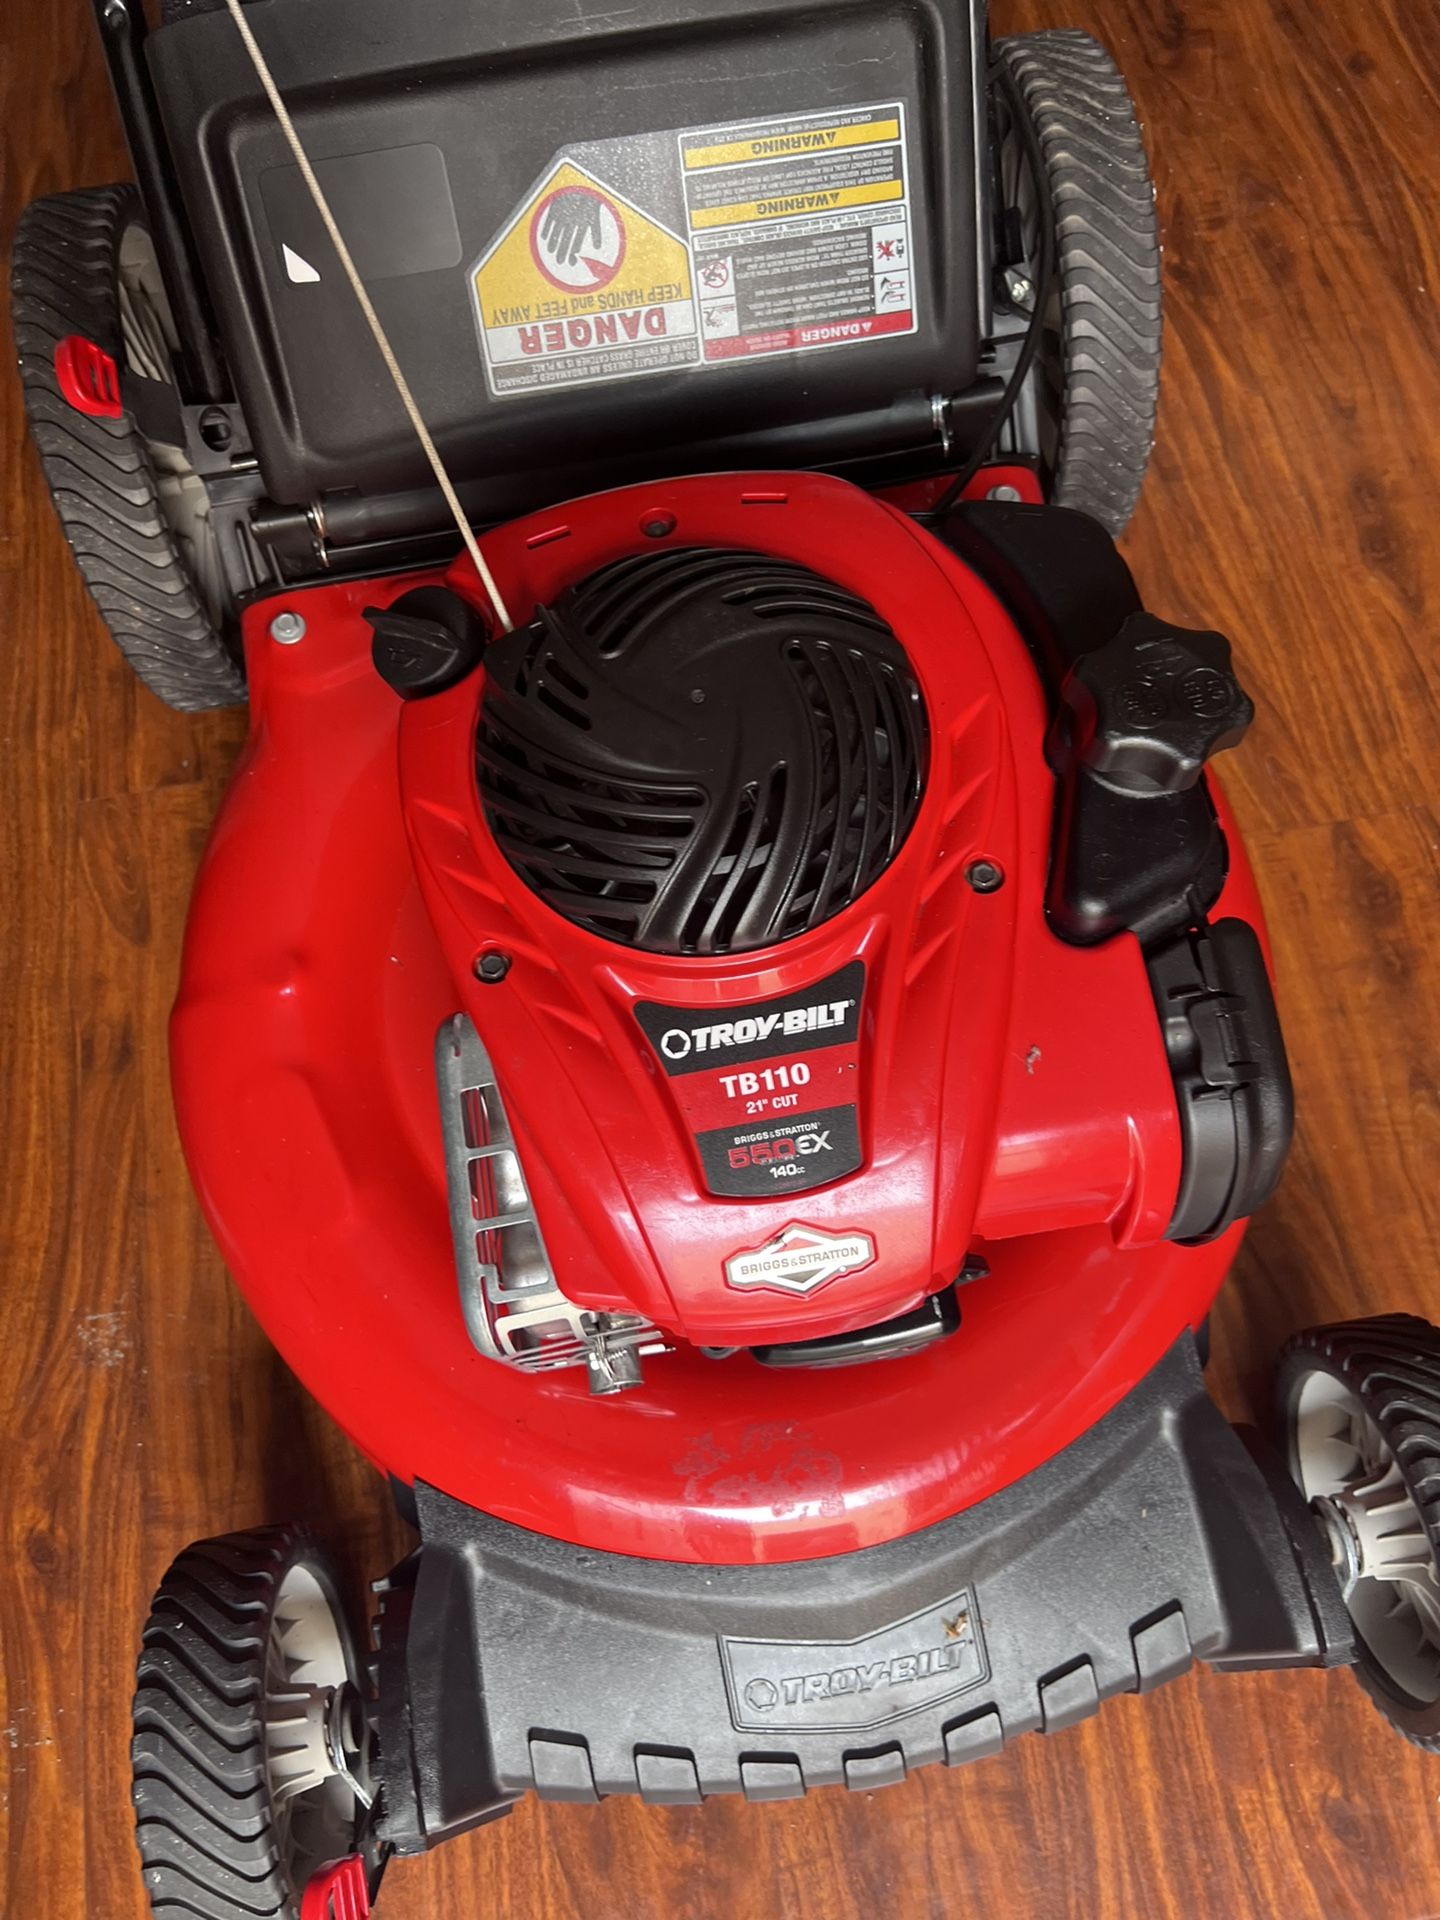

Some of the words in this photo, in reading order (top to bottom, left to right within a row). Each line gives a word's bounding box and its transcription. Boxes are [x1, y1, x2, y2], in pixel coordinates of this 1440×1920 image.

[750, 132, 825, 154] WARNING
[755, 193, 829, 215] WARNING
[597, 287, 644, 309] HANDS
[647, 282, 682, 302] KEEP
[490, 304, 531, 324] AWAY
[533, 299, 568, 318] FEET
[570, 295, 595, 313] and
[518, 306, 667, 355] DANGER
[800, 322, 859, 342] DANGER
[692, 1000, 850, 1052] TROY-BILT
[720, 1062, 811, 1098] TB110
[746, 1098, 768, 1114] 21"
[772, 1094, 799, 1110] CUT
[781, 1640, 967, 1706] TROY-BILT
